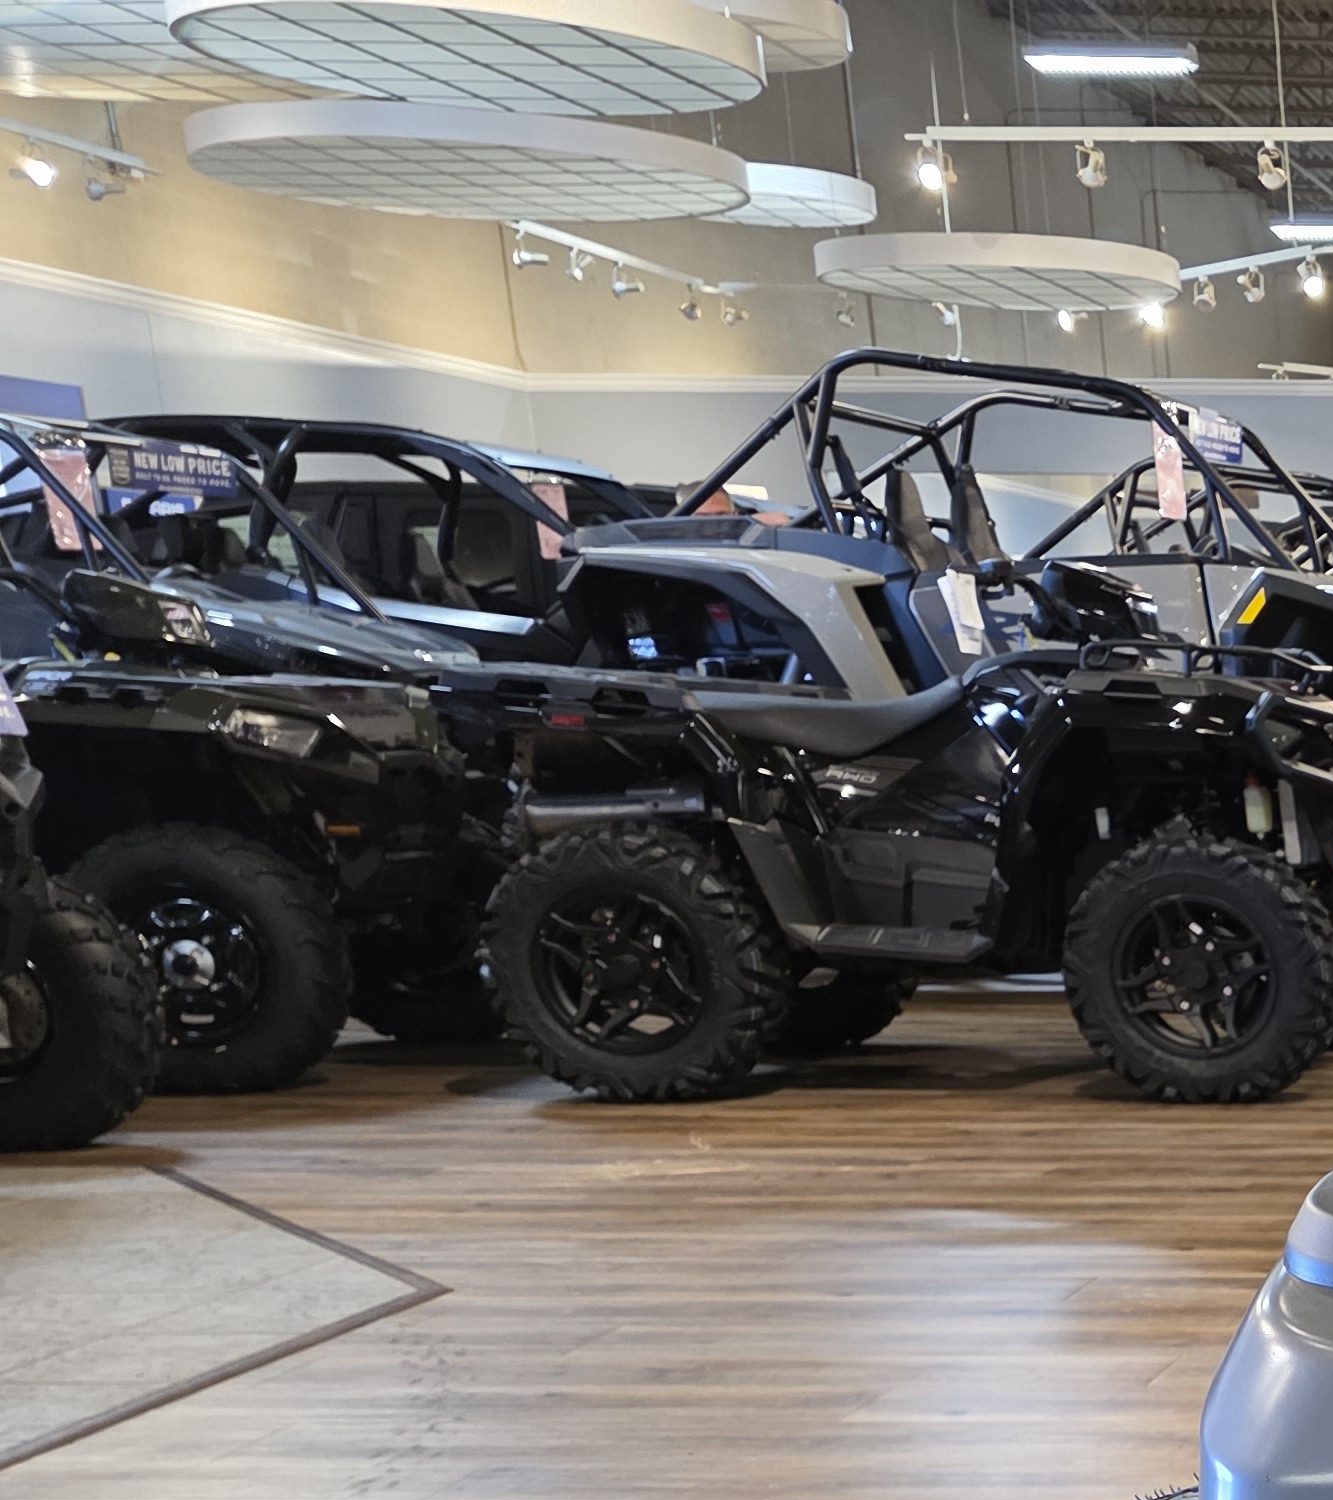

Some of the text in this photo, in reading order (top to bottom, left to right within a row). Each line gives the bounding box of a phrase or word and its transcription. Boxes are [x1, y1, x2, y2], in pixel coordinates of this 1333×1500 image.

[134, 452, 230, 477] NEW LOW PRICE
